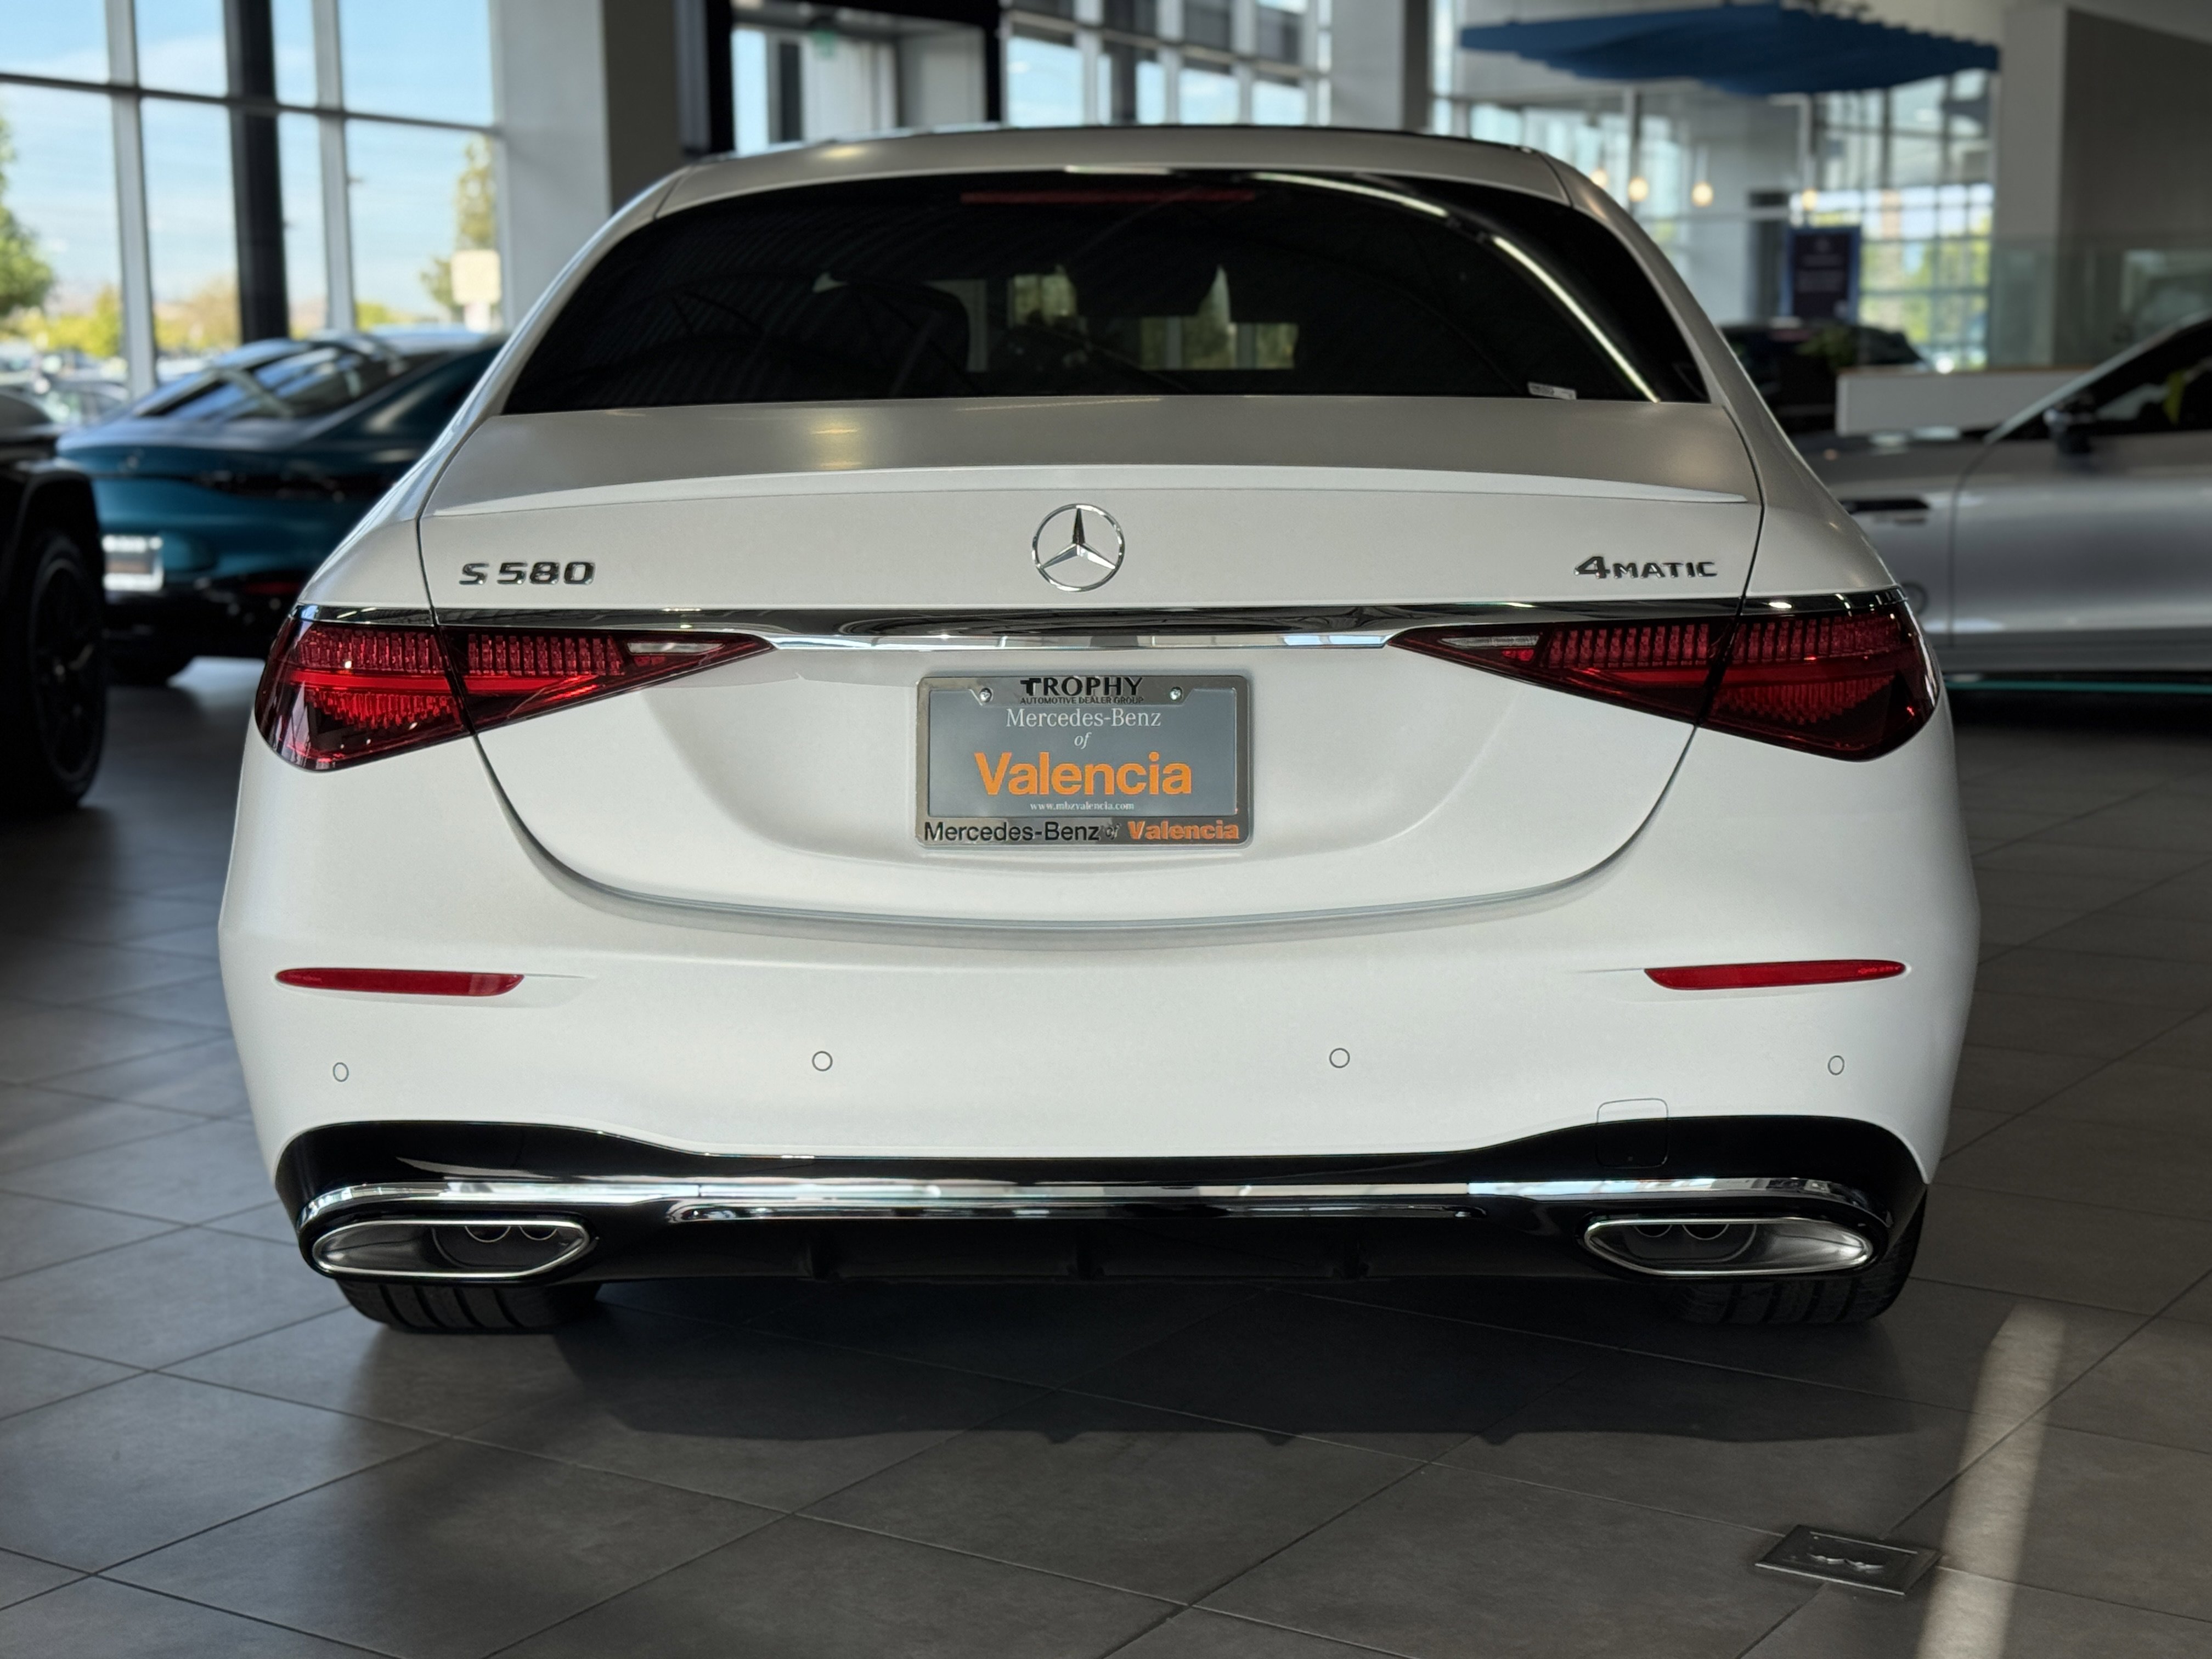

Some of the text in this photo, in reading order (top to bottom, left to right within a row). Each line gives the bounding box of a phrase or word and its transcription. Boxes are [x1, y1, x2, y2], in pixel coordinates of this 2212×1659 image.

[459, 562, 596, 585] S 580
[1573, 556, 1718, 579] 4MATIC
[1020, 676, 1143, 696] TROPHY
[1006, 708, 1161, 728] Mercedes-Benz
[1074, 732, 1092, 749] of
[974, 751, 1192, 795] Valencia
[1030, 801, 1135, 811] www.mbzvalencia.com
[924, 820, 1240, 842] Mercedes-Benz of Valencia
